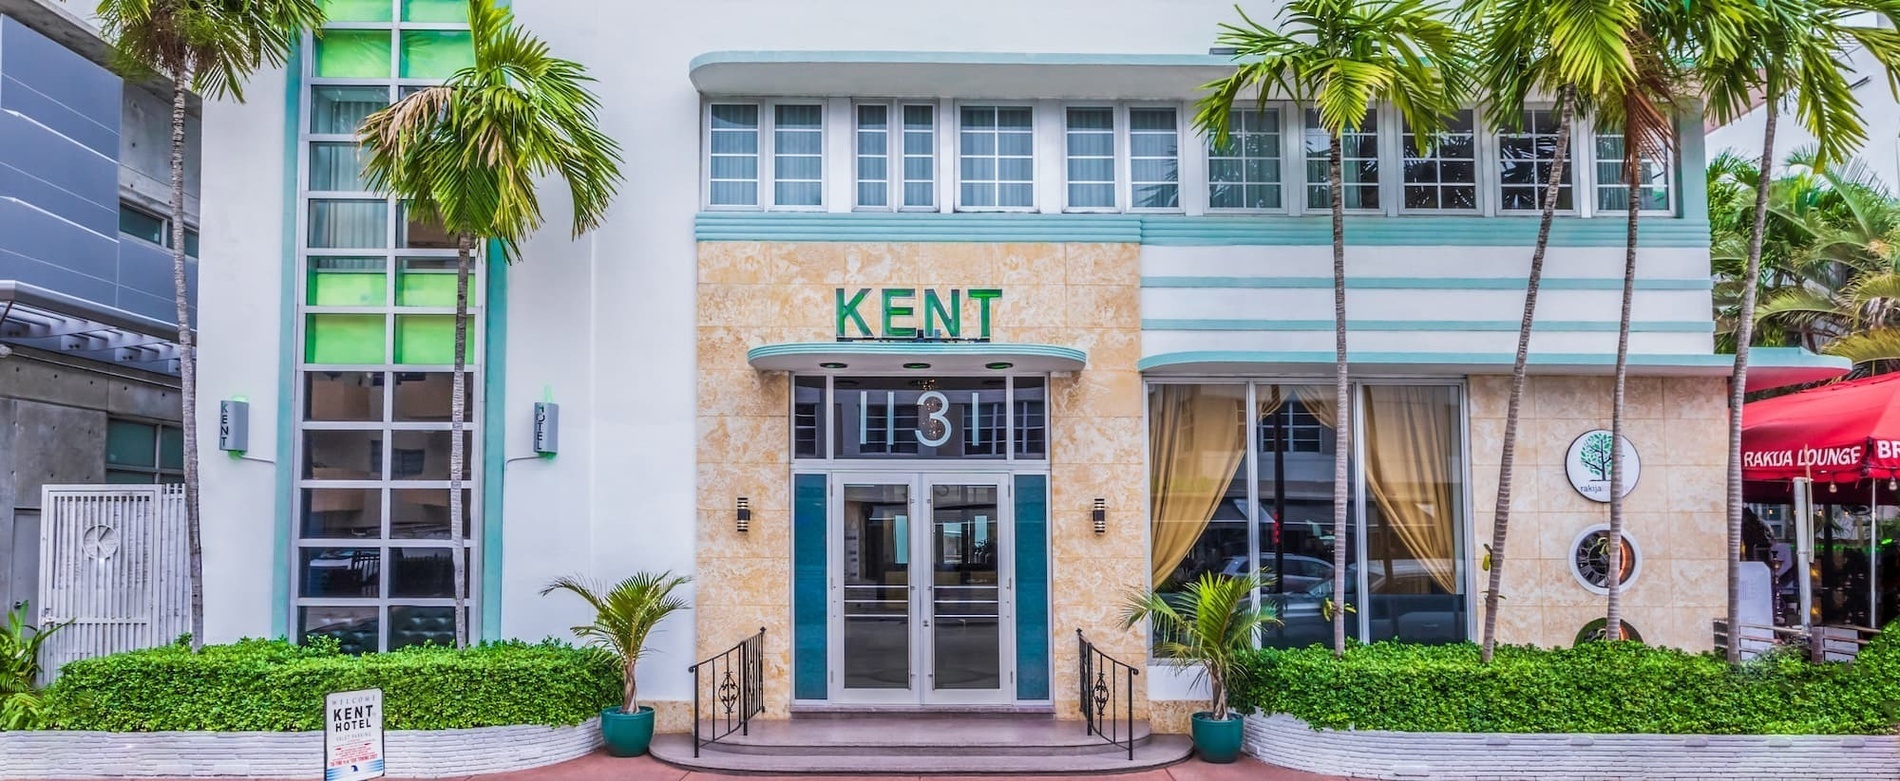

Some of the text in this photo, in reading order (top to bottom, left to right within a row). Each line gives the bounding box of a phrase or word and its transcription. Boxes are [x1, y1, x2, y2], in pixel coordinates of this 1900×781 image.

[836, 288, 1003, 337] KENT
[220, 403, 229, 447] KENT
[535, 404, 546, 450] HOTEL
[860, 391, 979, 447] 1131
[1743, 446, 1862, 467] RAKIJA LOUNGE
[333, 705, 373, 721] KENT
[335, 719, 371, 732] HOTEL
